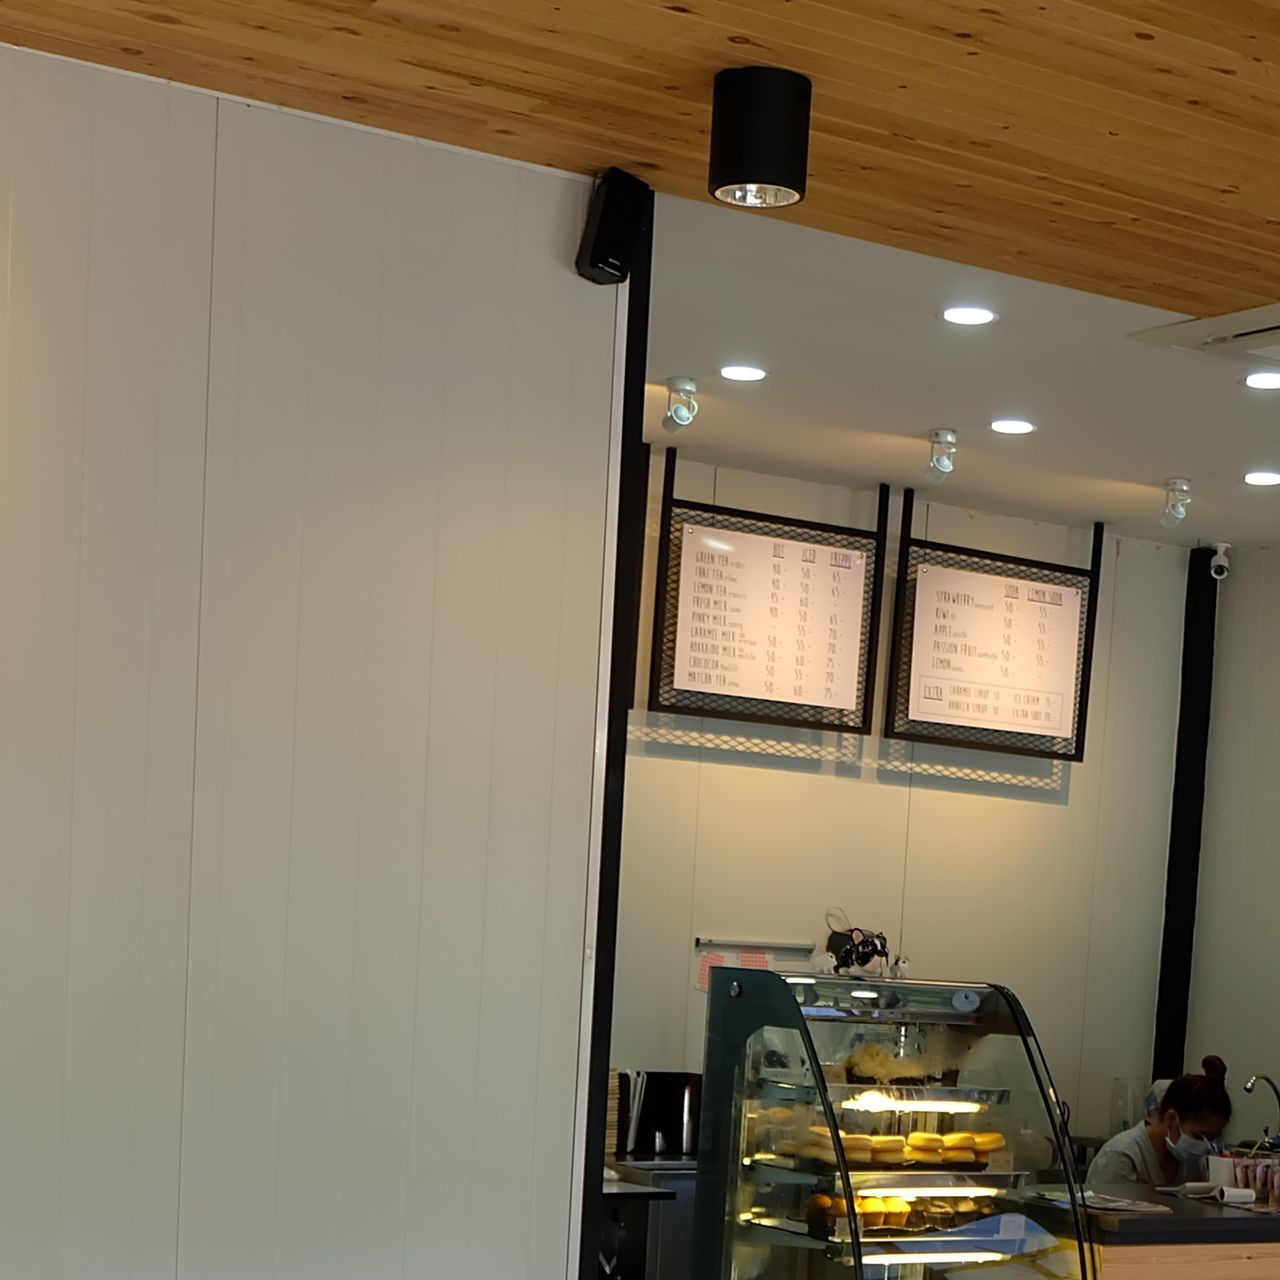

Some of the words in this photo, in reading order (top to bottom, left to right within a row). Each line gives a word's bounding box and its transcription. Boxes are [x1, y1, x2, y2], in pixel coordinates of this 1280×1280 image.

[696, 551, 715, 565] GREEN
[718, 554, 729, 566] TEA
[801, 548, 816, 562] ICED
[713, 569, 723, 580] TEA
[693, 581, 713, 594] LEMON
[716, 584, 727, 597] TEA
[1004, 584, 1019, 596] SODA
[692, 596, 710, 609] FRESH
[713, 600, 727, 612] MILK
[936, 590, 975, 607] STRAWBERRY
[713, 615, 727, 626] MILK
[691, 626, 718, 641] CARAMEL
[721, 631, 735, 642] MILK
[934, 624, 952, 638] APPLE
[722, 646, 736, 657] MILK
[933, 640, 958, 654] PASSION
[960, 644, 977, 657] FRUIT
[932, 656, 951, 670] LEMON
[688, 671, 712, 684] MATCHA
[716, 674, 726, 686] TEA
